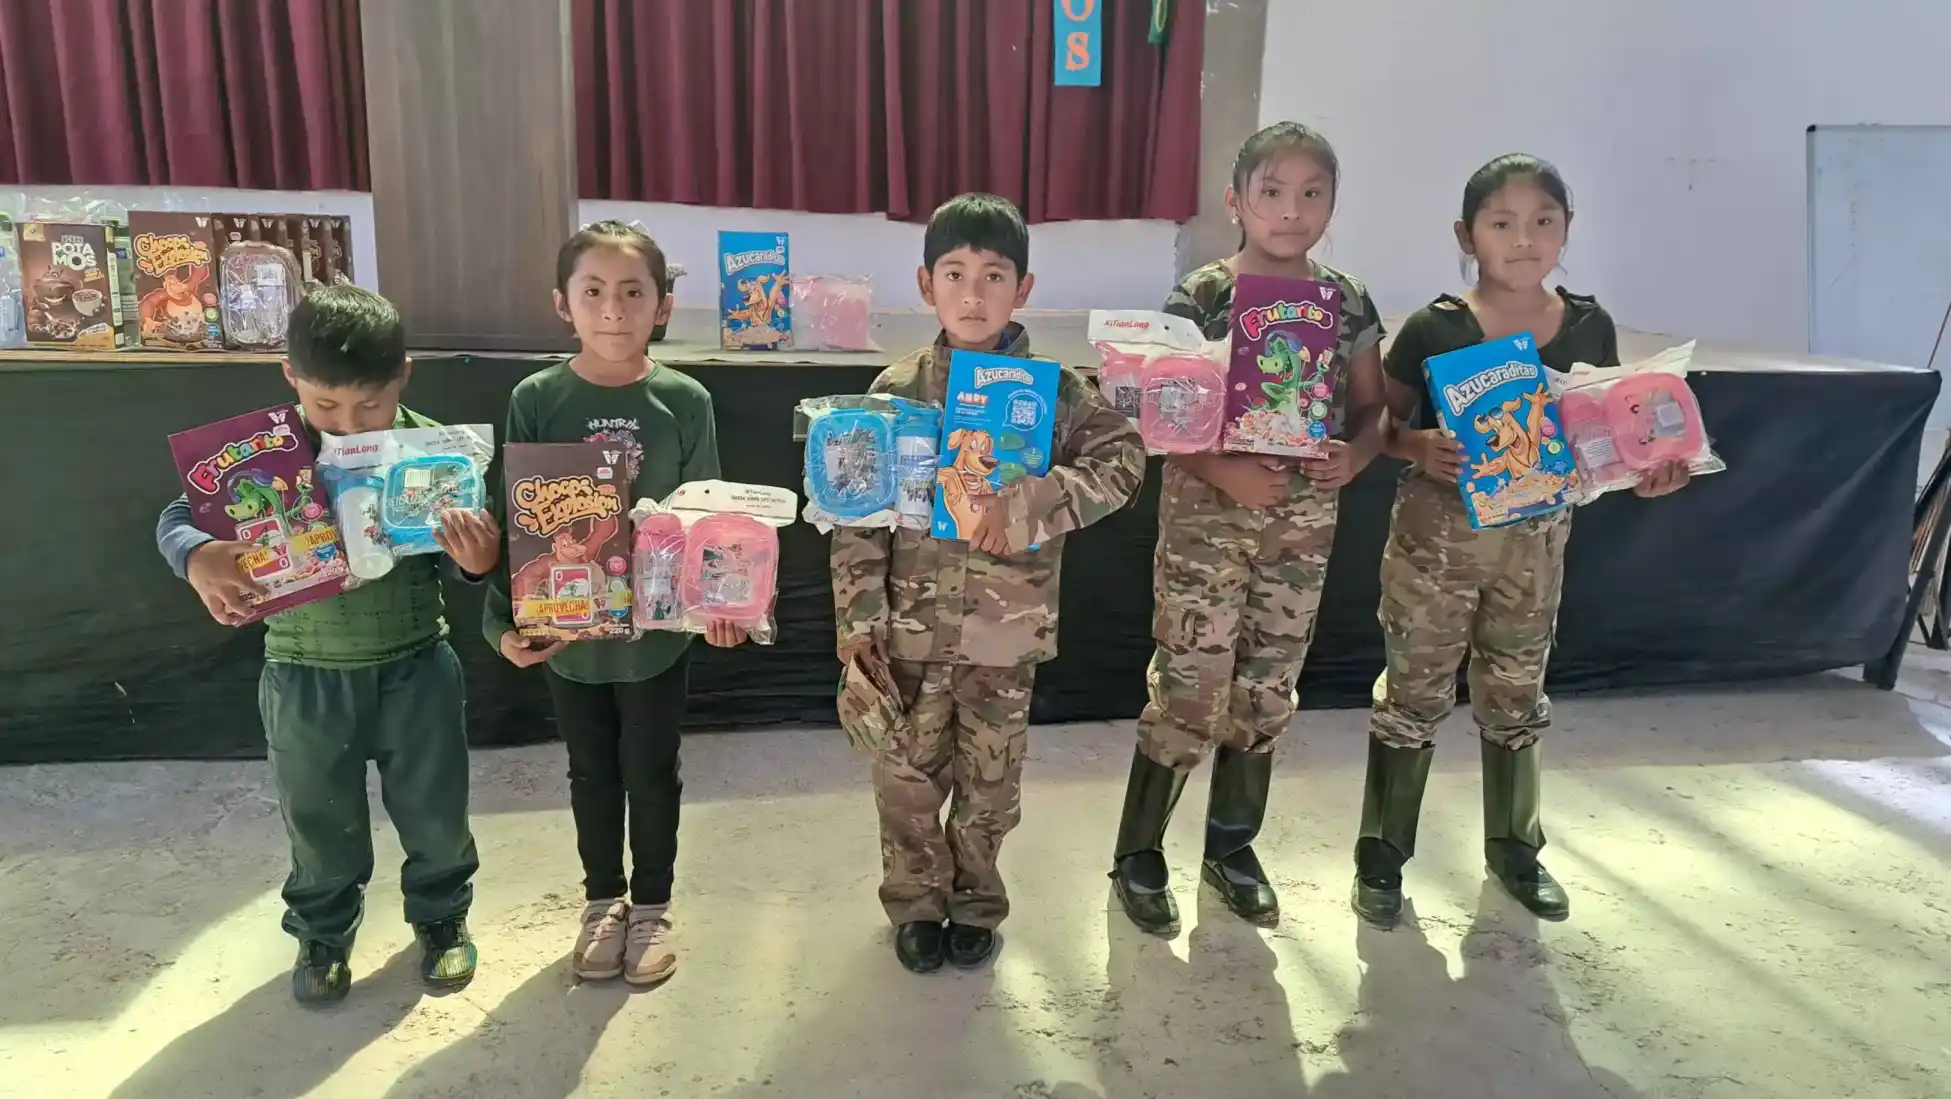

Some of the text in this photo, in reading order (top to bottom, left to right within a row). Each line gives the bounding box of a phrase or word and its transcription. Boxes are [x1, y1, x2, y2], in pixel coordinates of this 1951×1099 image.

[52, 242, 94, 256] POTA
[53, 252, 97, 270] MOS
[1444, 361, 1537, 414] Azucaraditas
